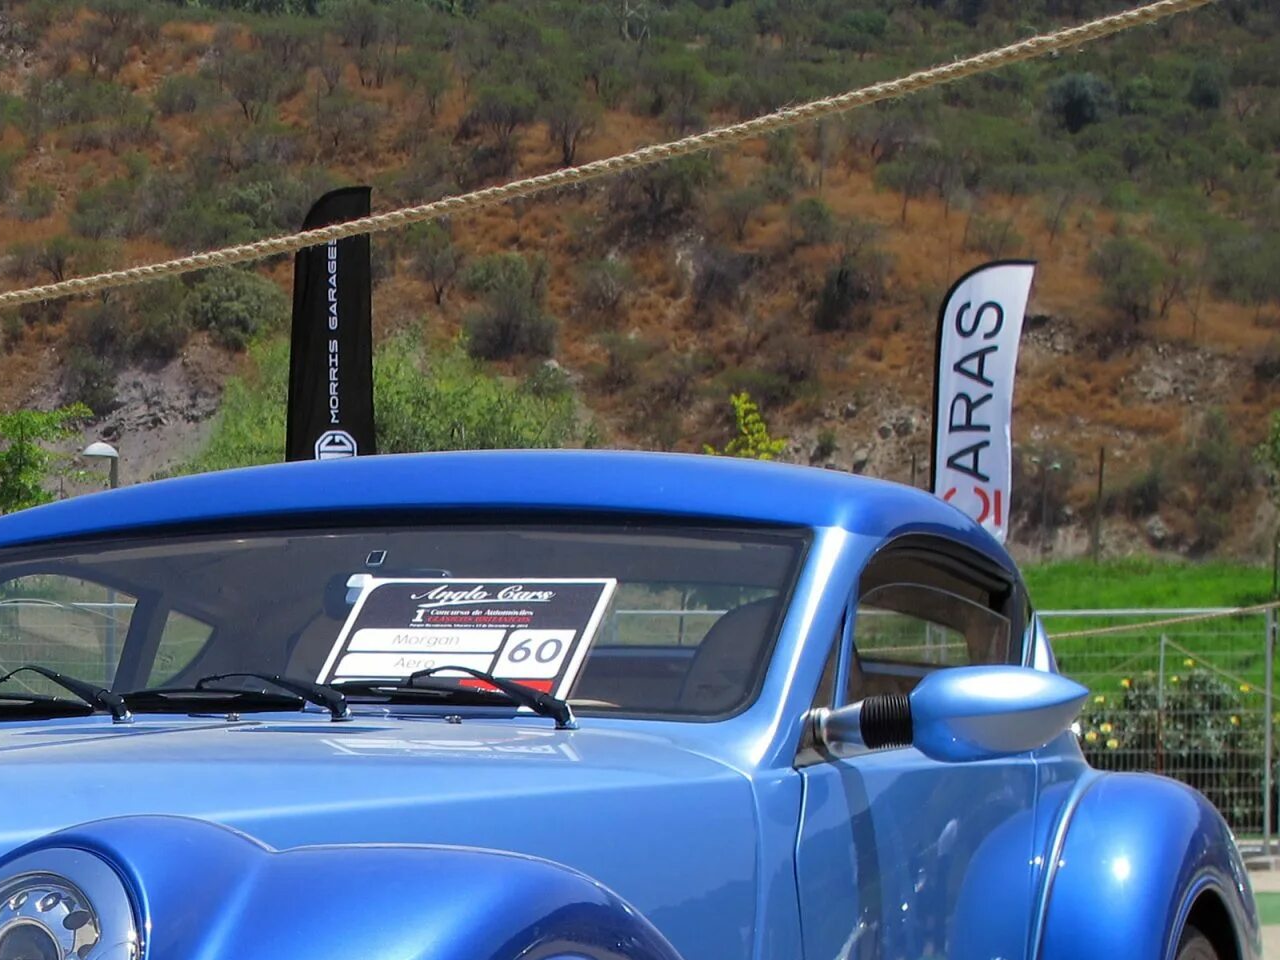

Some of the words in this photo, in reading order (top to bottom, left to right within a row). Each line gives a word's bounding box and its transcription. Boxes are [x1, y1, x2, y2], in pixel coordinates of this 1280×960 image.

[328, 339, 340, 424] MORRIS
[410, 584, 492, 604] Anglo
[497, 584, 557, 601] Cars
[392, 634, 461, 647] Morgan
[507, 637, 563, 664] 60
[393, 656, 436, 670] Aero
